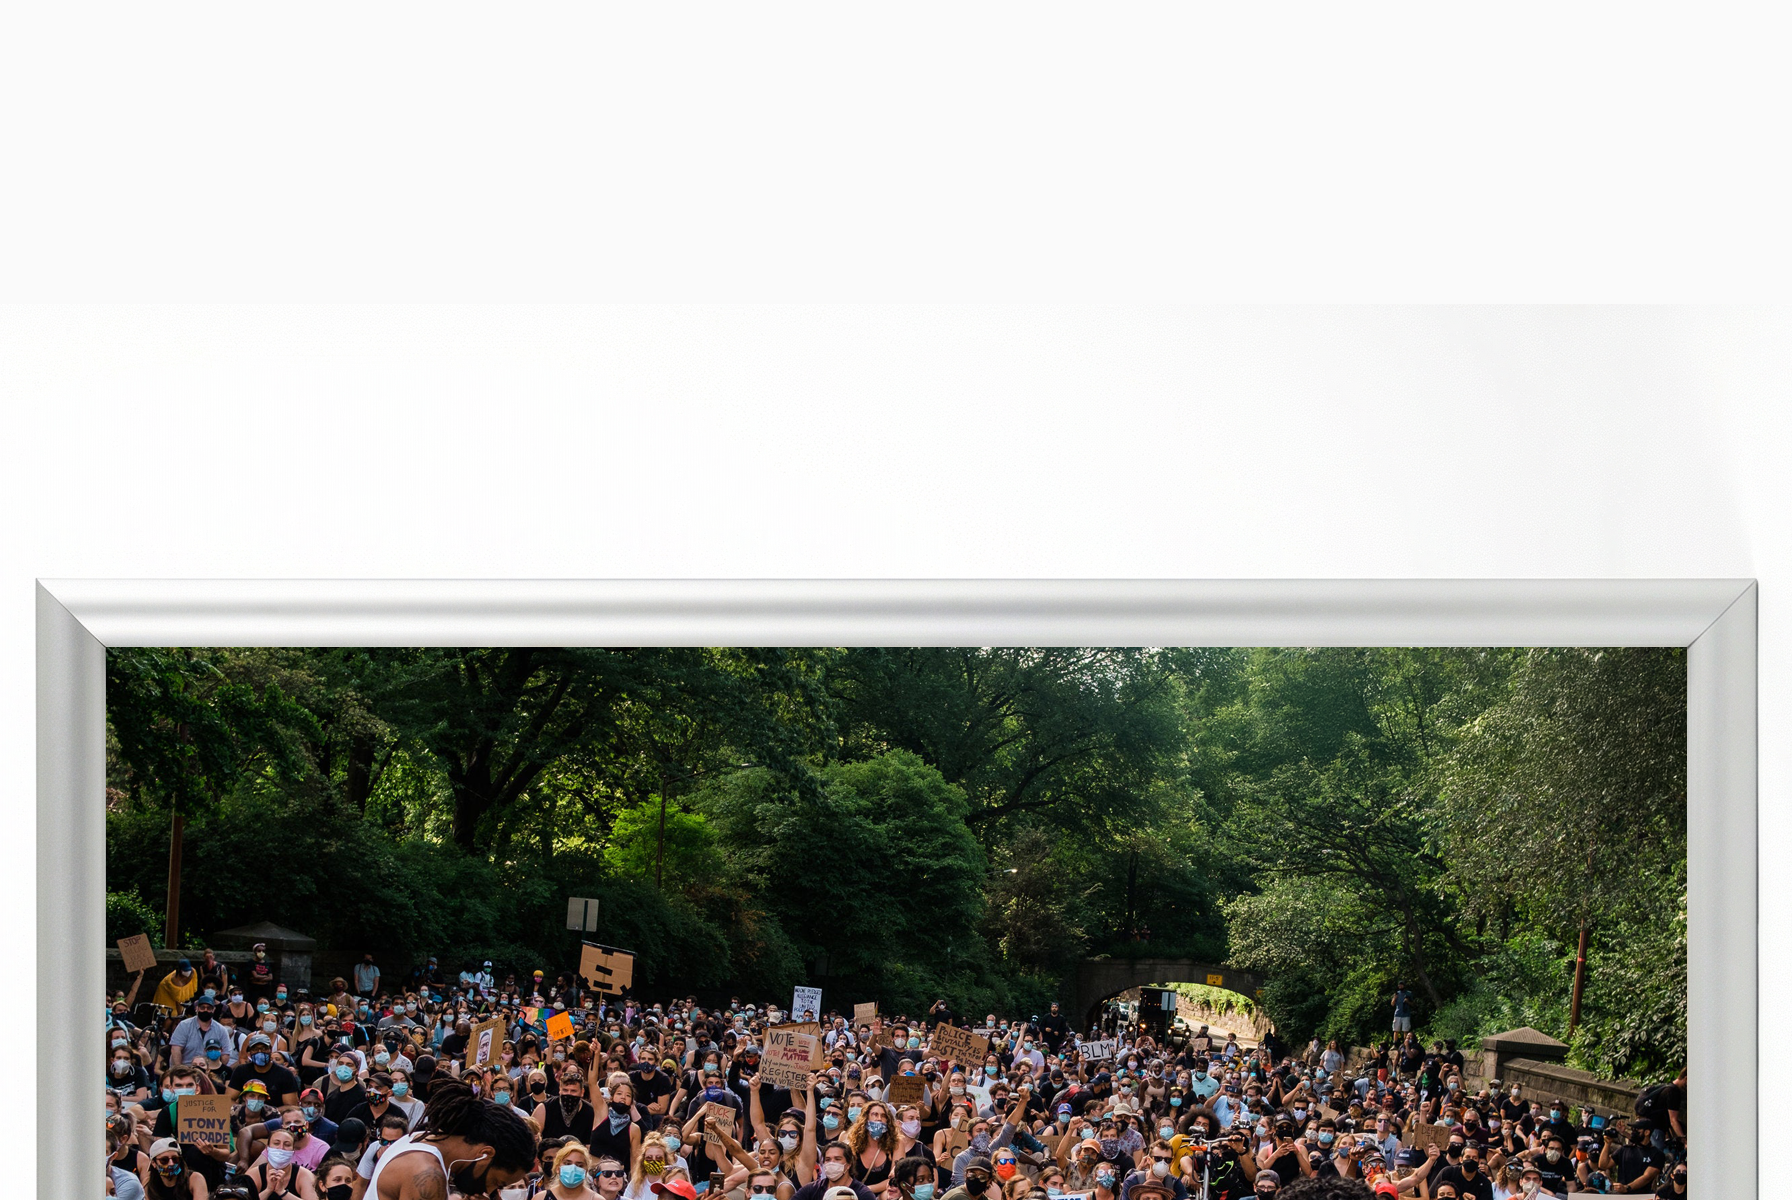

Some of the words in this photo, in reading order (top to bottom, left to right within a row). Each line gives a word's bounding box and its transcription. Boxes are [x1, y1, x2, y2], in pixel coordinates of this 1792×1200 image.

[124, 936, 141, 948] STOP
[770, 1032, 794, 1047] VOTE
[939, 1026, 972, 1045] POLICE
[931, 1040, 957, 1055] JUST
[937, 1035, 973, 1052] BRUTALITY
[781, 1053, 810, 1062] MATTER
[1081, 1043, 1111, 1060] BLM
[762, 1067, 807, 1083] REGISTER
[708, 1104, 730, 1119] FUCK
[183, 1118, 226, 1130] TONY
[181, 1131, 230, 1144] MCDADE
